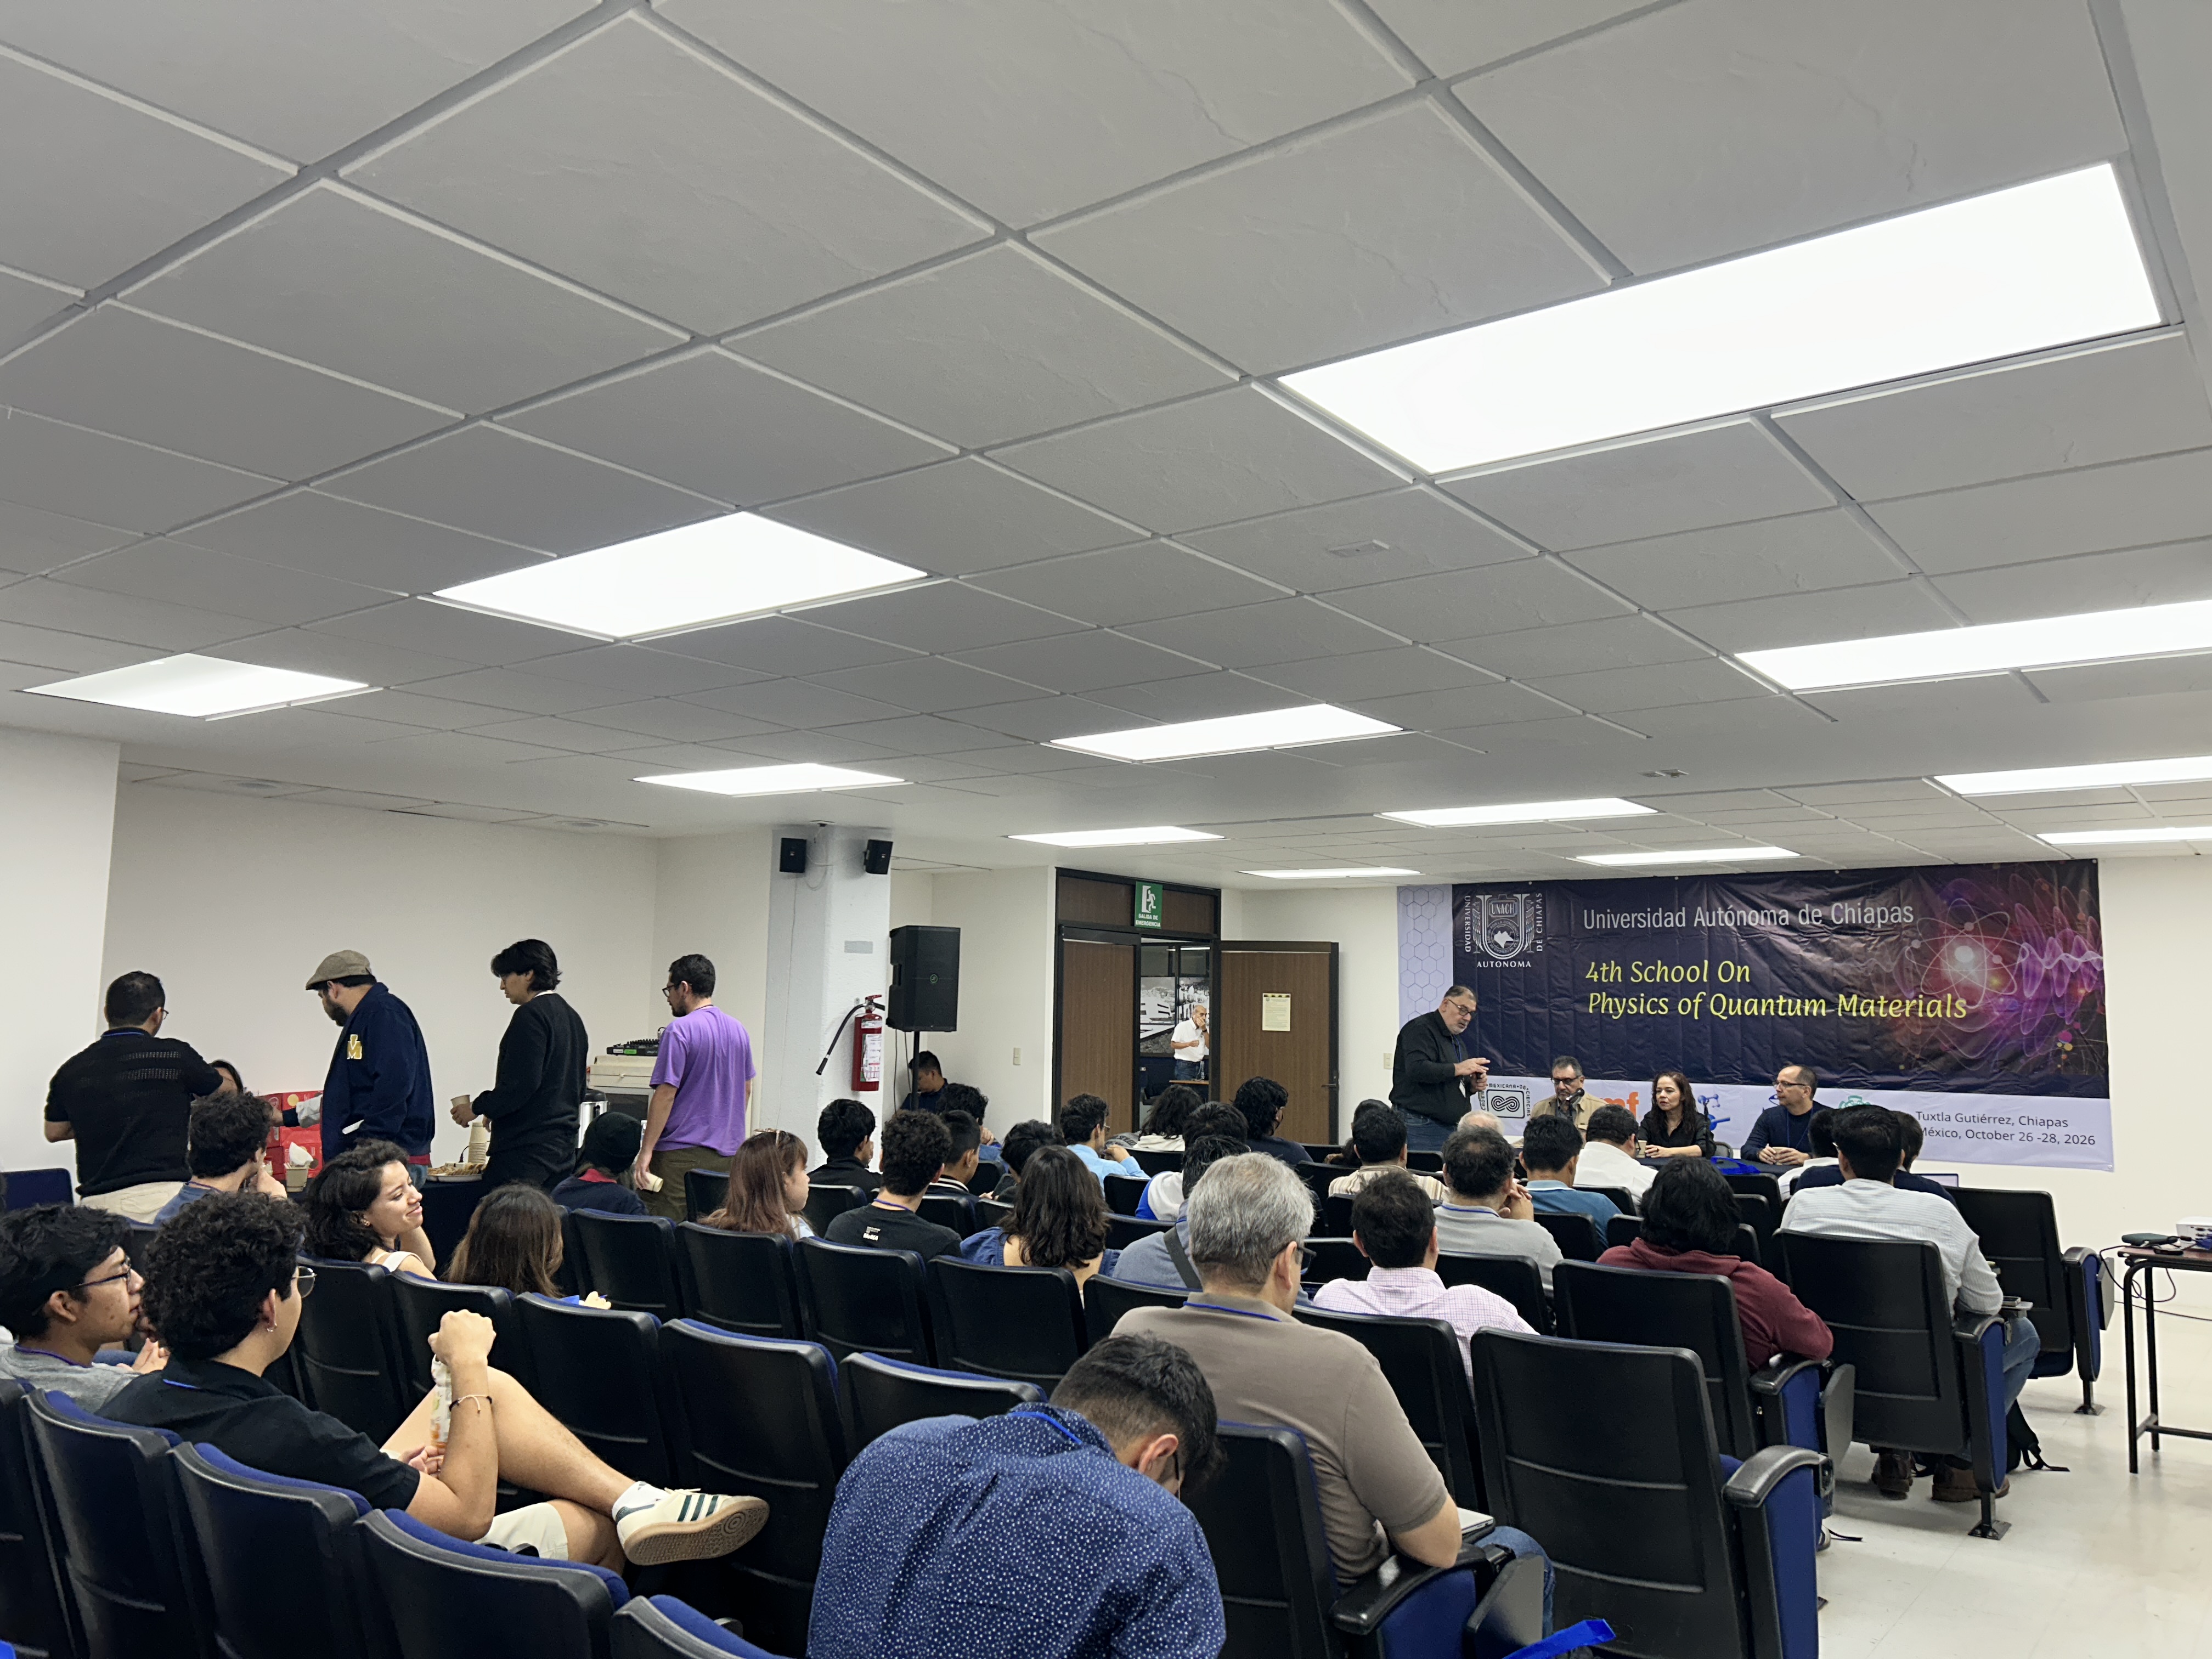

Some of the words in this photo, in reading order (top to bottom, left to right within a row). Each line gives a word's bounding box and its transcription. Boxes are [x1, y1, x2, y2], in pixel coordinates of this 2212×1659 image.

[1491, 903, 1515, 915] UNACH
[1584, 907, 1686, 929] Universidad
[1694, 905, 1790, 927] Autónoma
[1798, 904, 1822, 926] de
[1831, 902, 1914, 929] Chiapas
[1536, 939, 1543, 951] DE
[1585, 960, 1622, 983] 4th
[1630, 960, 1708, 983] School
[1718, 960, 1751, 983] On
[1589, 992, 1669, 1019] Physics
[1678, 991, 1706, 1020] of
[1710, 994, 1826, 1020] Quantum
[1838, 994, 1967, 1019] Materials
[1916, 1111, 1951, 1122] Tuxtla
[1955, 1113, 2015, 1126] Gutiérrez,
[2019, 1116, 2068, 1128] Chiapas
[1965, 1128, 2015, 1141] October
[2018, 1132, 2033, 1142] 26
[2037, 1133, 2060, 1145] -28,
[2064, 1134, 2095, 1145] 2026
